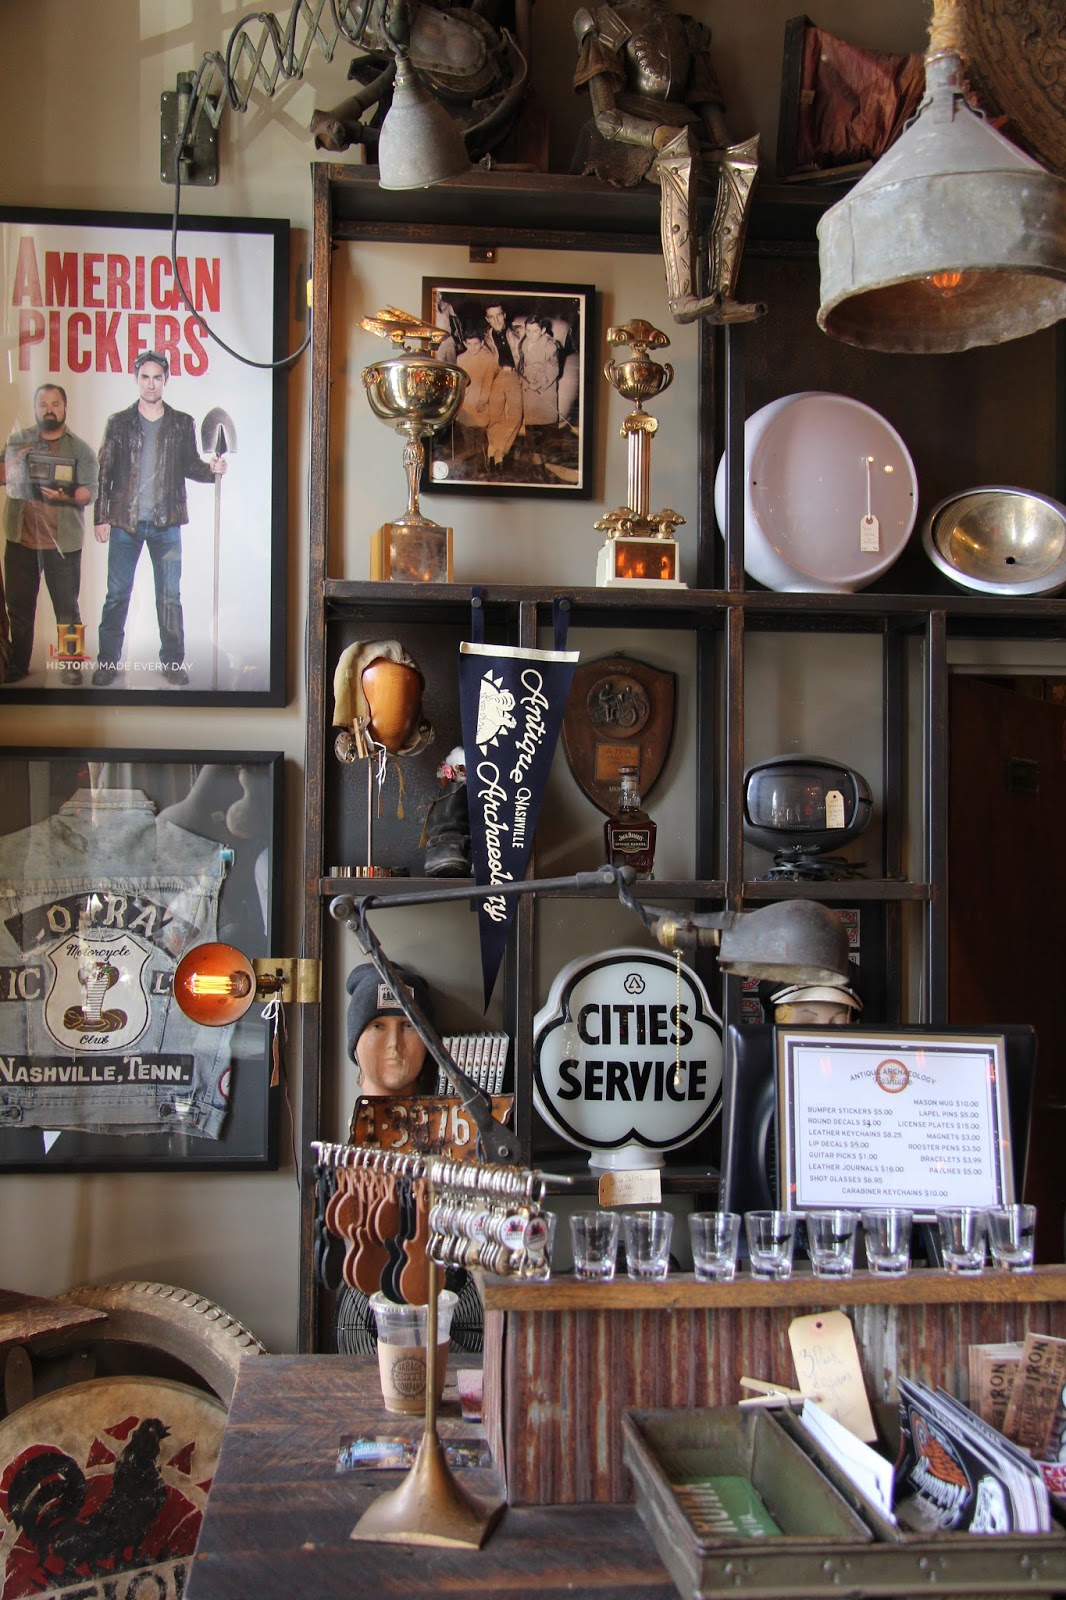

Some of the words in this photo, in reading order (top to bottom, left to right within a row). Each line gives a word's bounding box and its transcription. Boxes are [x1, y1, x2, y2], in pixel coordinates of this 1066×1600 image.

[12, 236, 221, 312] AMERICAN
[19, 309, 209, 376] PICKERS
[46, 661, 96, 671] HISTORY
[100, 661, 131, 671] MADE
[134, 662, 169, 671] EVERY
[172, 662, 193, 672] DAY
[509, 668, 549, 784] Antique
[476, 761, 514, 923] Archaeoloy
[66, 943, 131, 959] Motorcycle
[0, 967, 41, 1000] IC
[79, 1034, 110, 1046] Club
[577, 1003, 694, 1046] CITIES
[124, 1056, 190, 1081] TENN.
[557, 1059, 707, 1102] SERVICE
[850, 1069, 881, 1081] ANTIQUE
[883, 1068, 937, 1085] ARCHAEOLOGY
[963, 1156, 981, 1164] $3.99
[1026, 1340, 1049, 1383] IRON
[990, 1363, 1006, 1406] IRON
